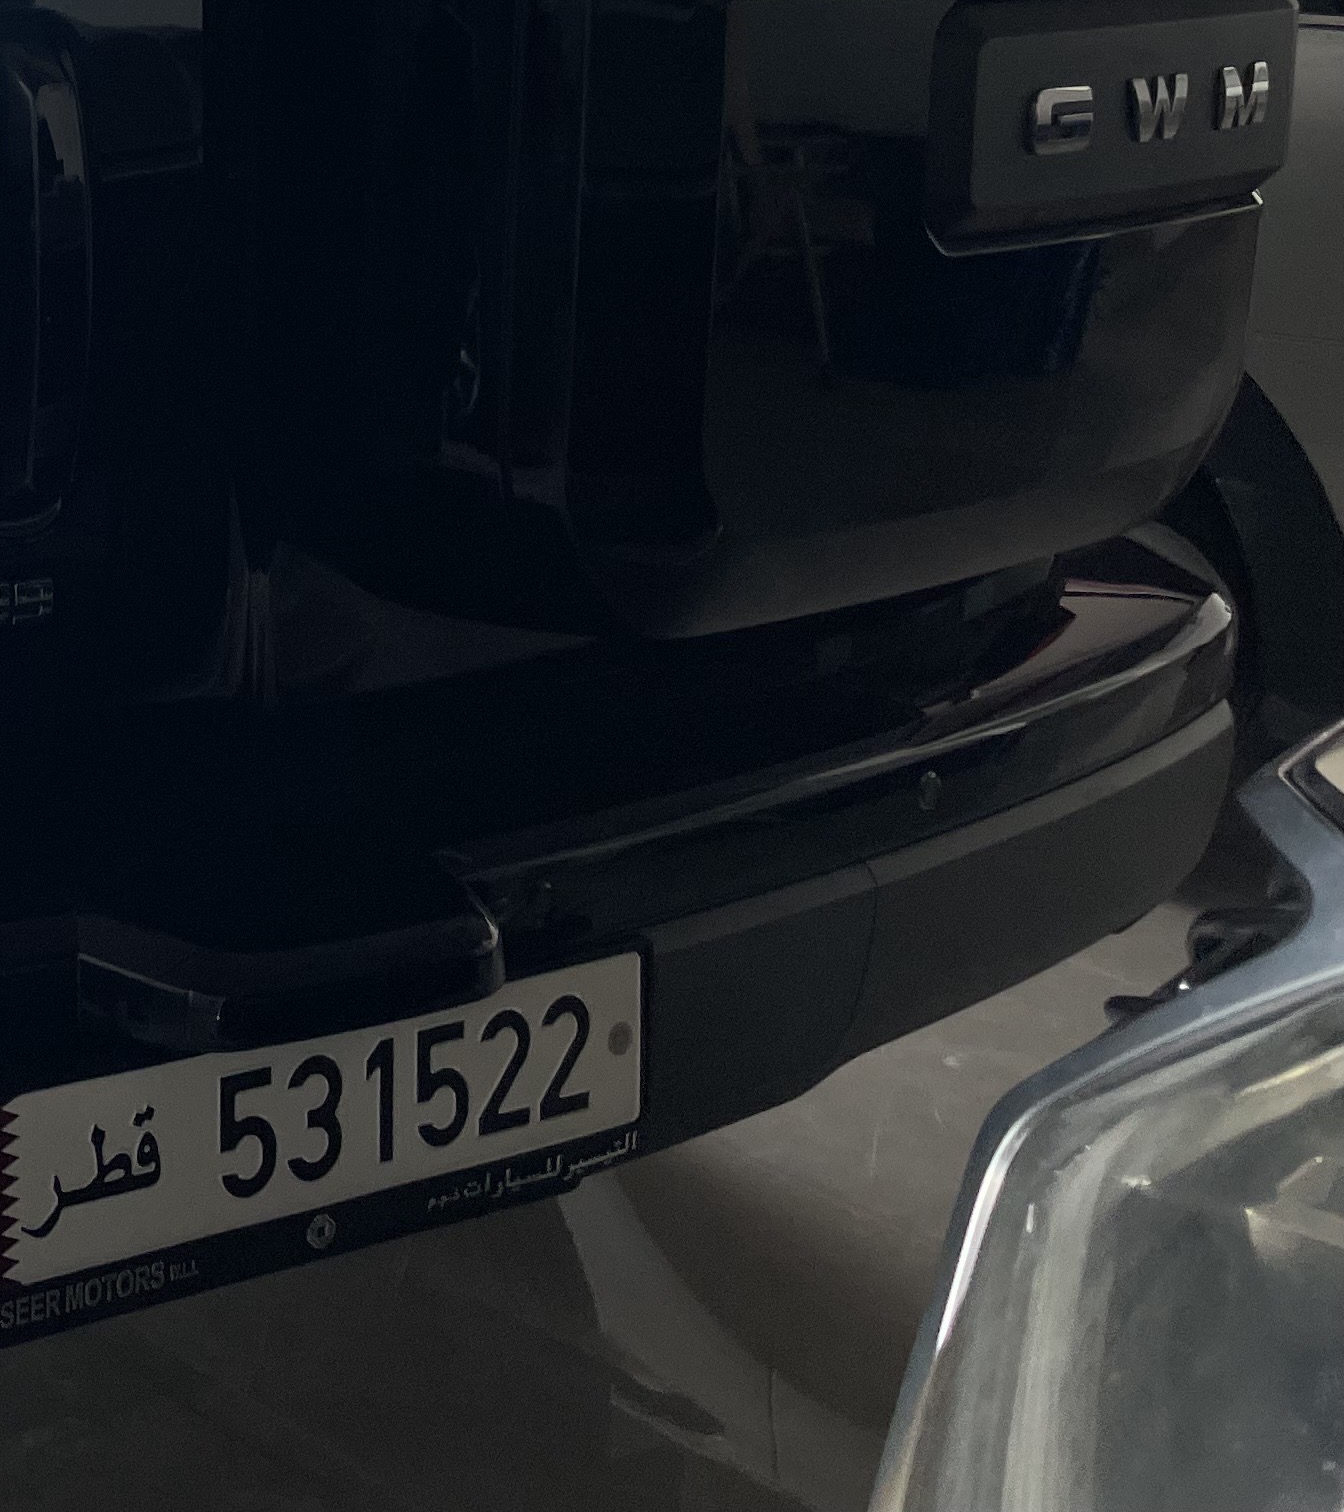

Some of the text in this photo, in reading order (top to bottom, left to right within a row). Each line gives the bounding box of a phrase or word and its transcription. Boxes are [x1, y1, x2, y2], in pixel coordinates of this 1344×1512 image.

[217, 994, 592, 1200] 531522
[20, 1104, 161, 1237] قطر
[65, 1259, 166, 1314] MOTORS
